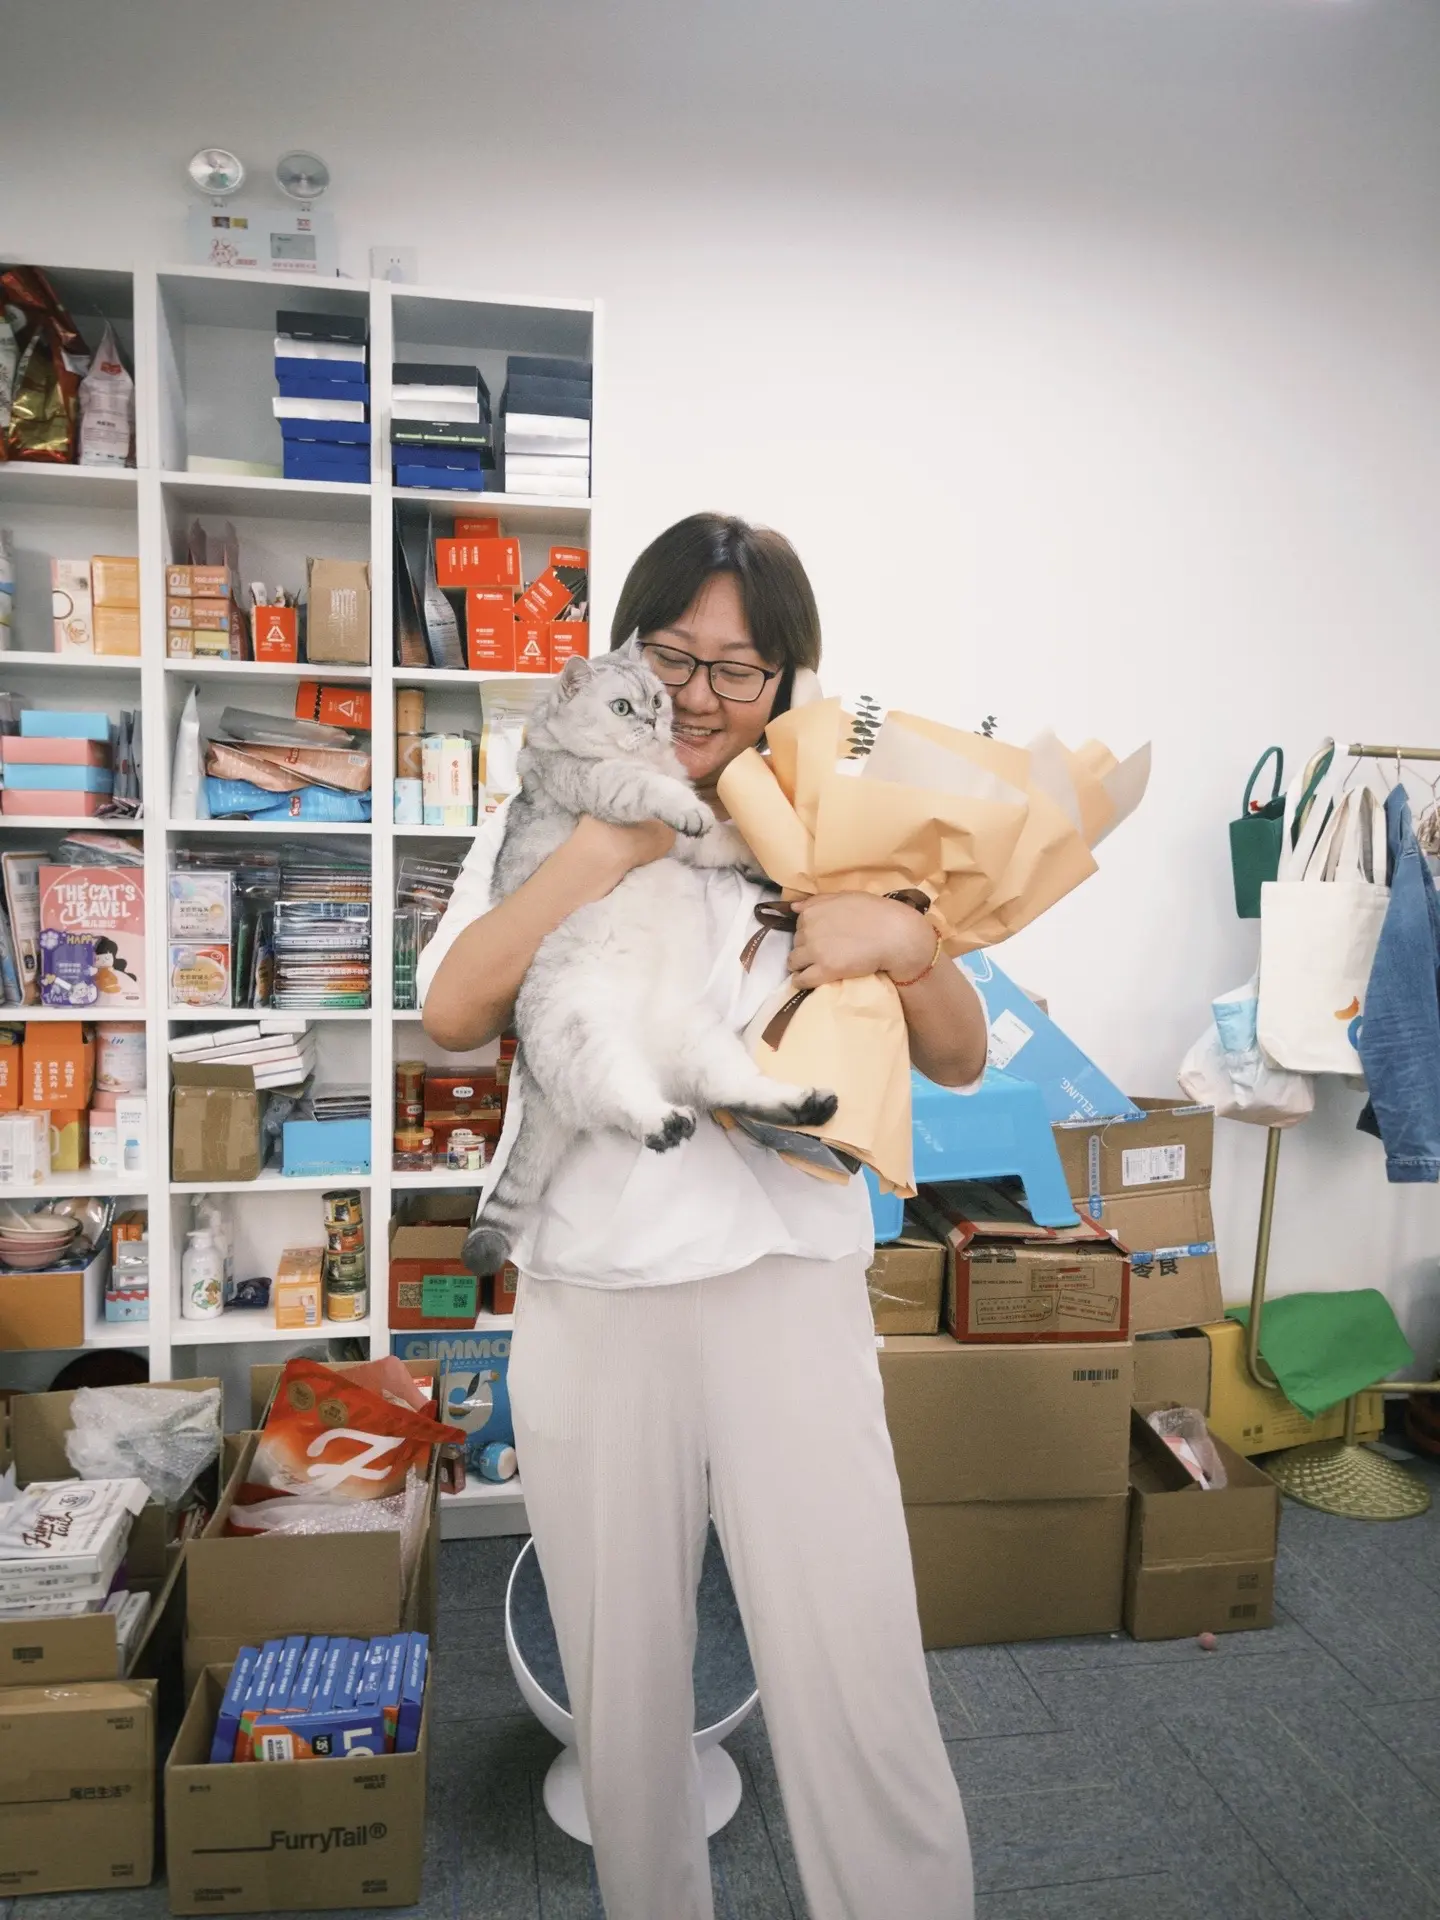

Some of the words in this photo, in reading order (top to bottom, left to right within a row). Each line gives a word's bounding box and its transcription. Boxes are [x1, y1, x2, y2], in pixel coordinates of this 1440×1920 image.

[54, 883, 87, 902] THE
[89, 884, 136, 902] CAT'S
[66, 900, 131, 919] TRAVEL
[66, 934, 98, 947] HAPPY
